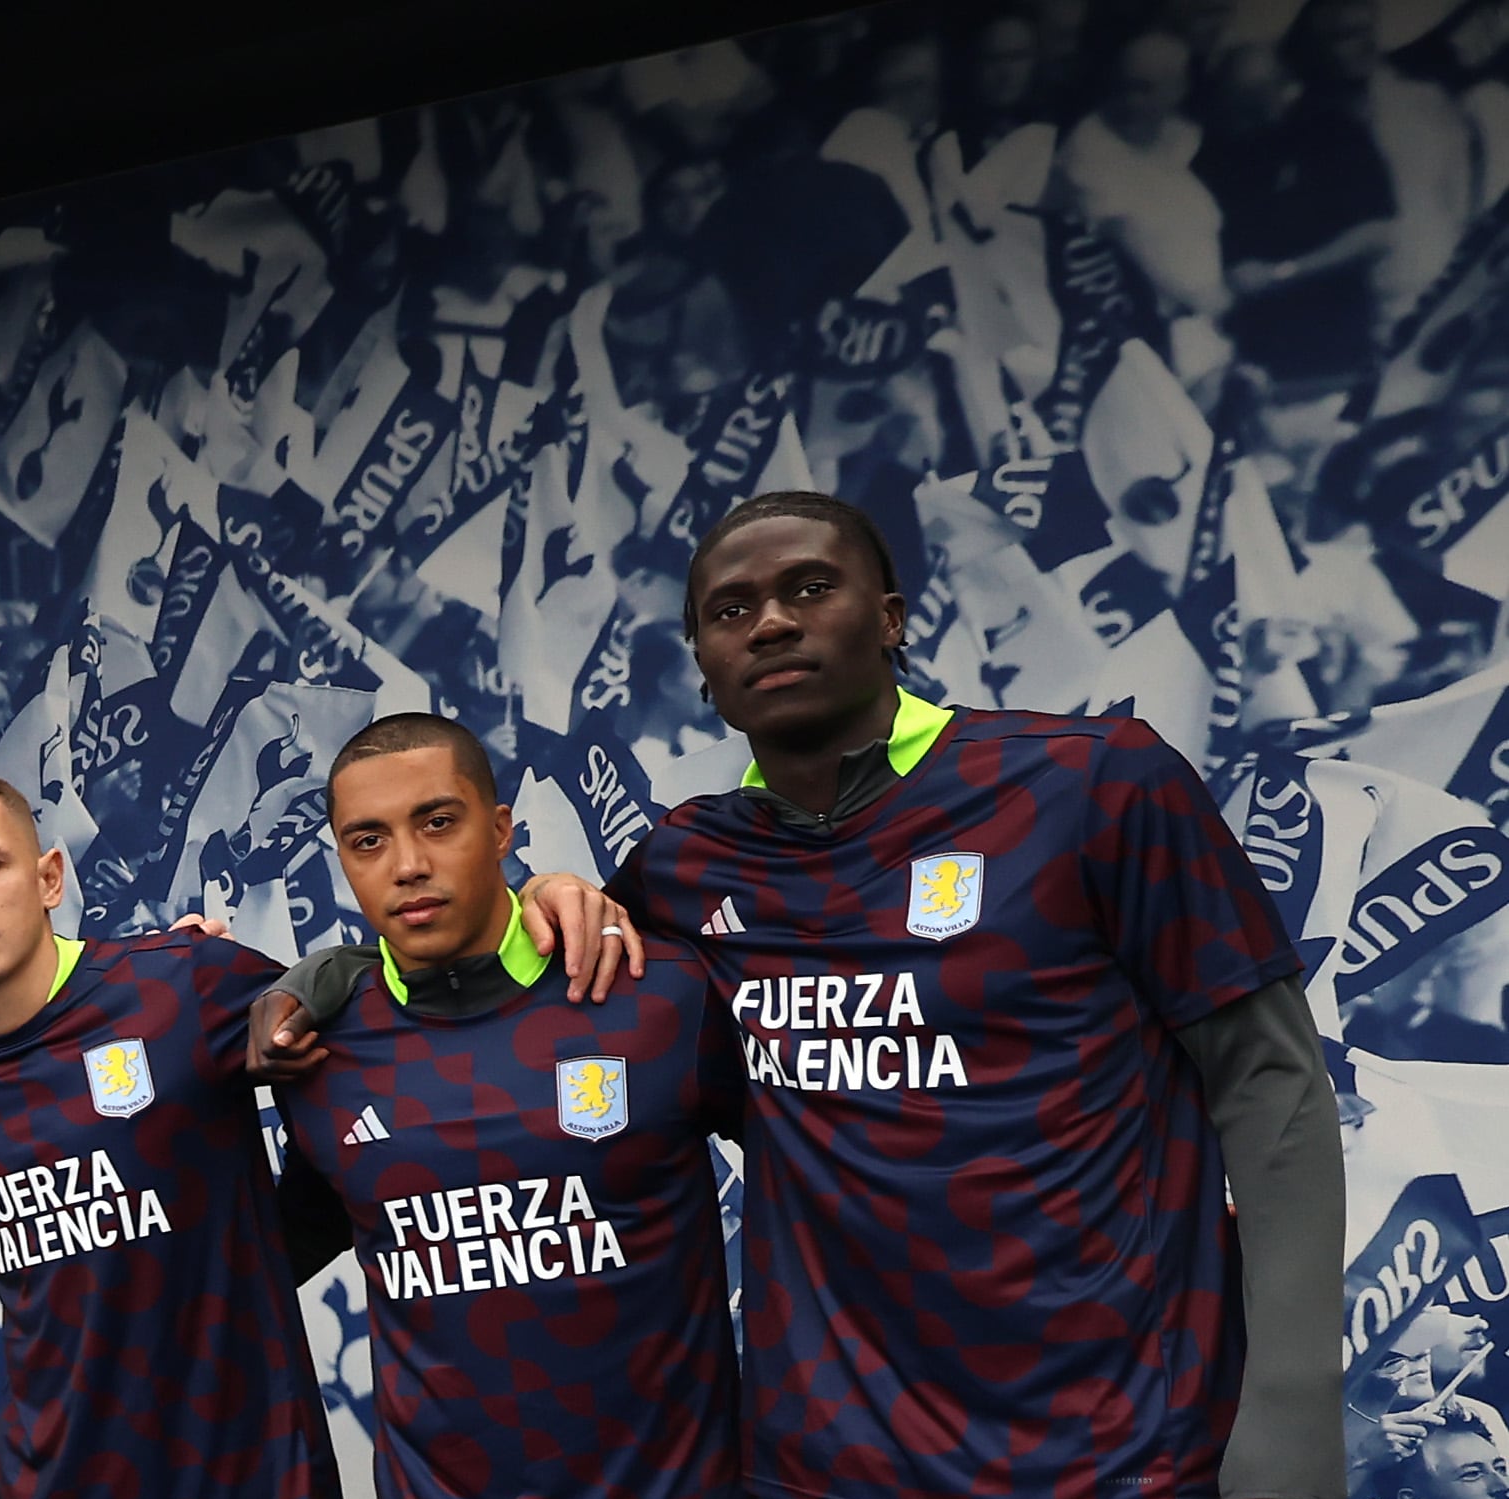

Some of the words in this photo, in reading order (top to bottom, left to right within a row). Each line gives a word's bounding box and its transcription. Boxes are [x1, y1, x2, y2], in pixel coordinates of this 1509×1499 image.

[912, 922, 943, 934] ASTON
[944, 917, 971, 933] VILLA
[732, 972, 925, 1030] FUERZA
[739, 1031, 969, 1091] VALENCIA
[567, 1121, 596, 1134] ASTON
[597, 1119, 622, 1134] VILLA
[383, 1175, 597, 1247] FUERZA
[376, 1220, 627, 1300] VALENCIA
